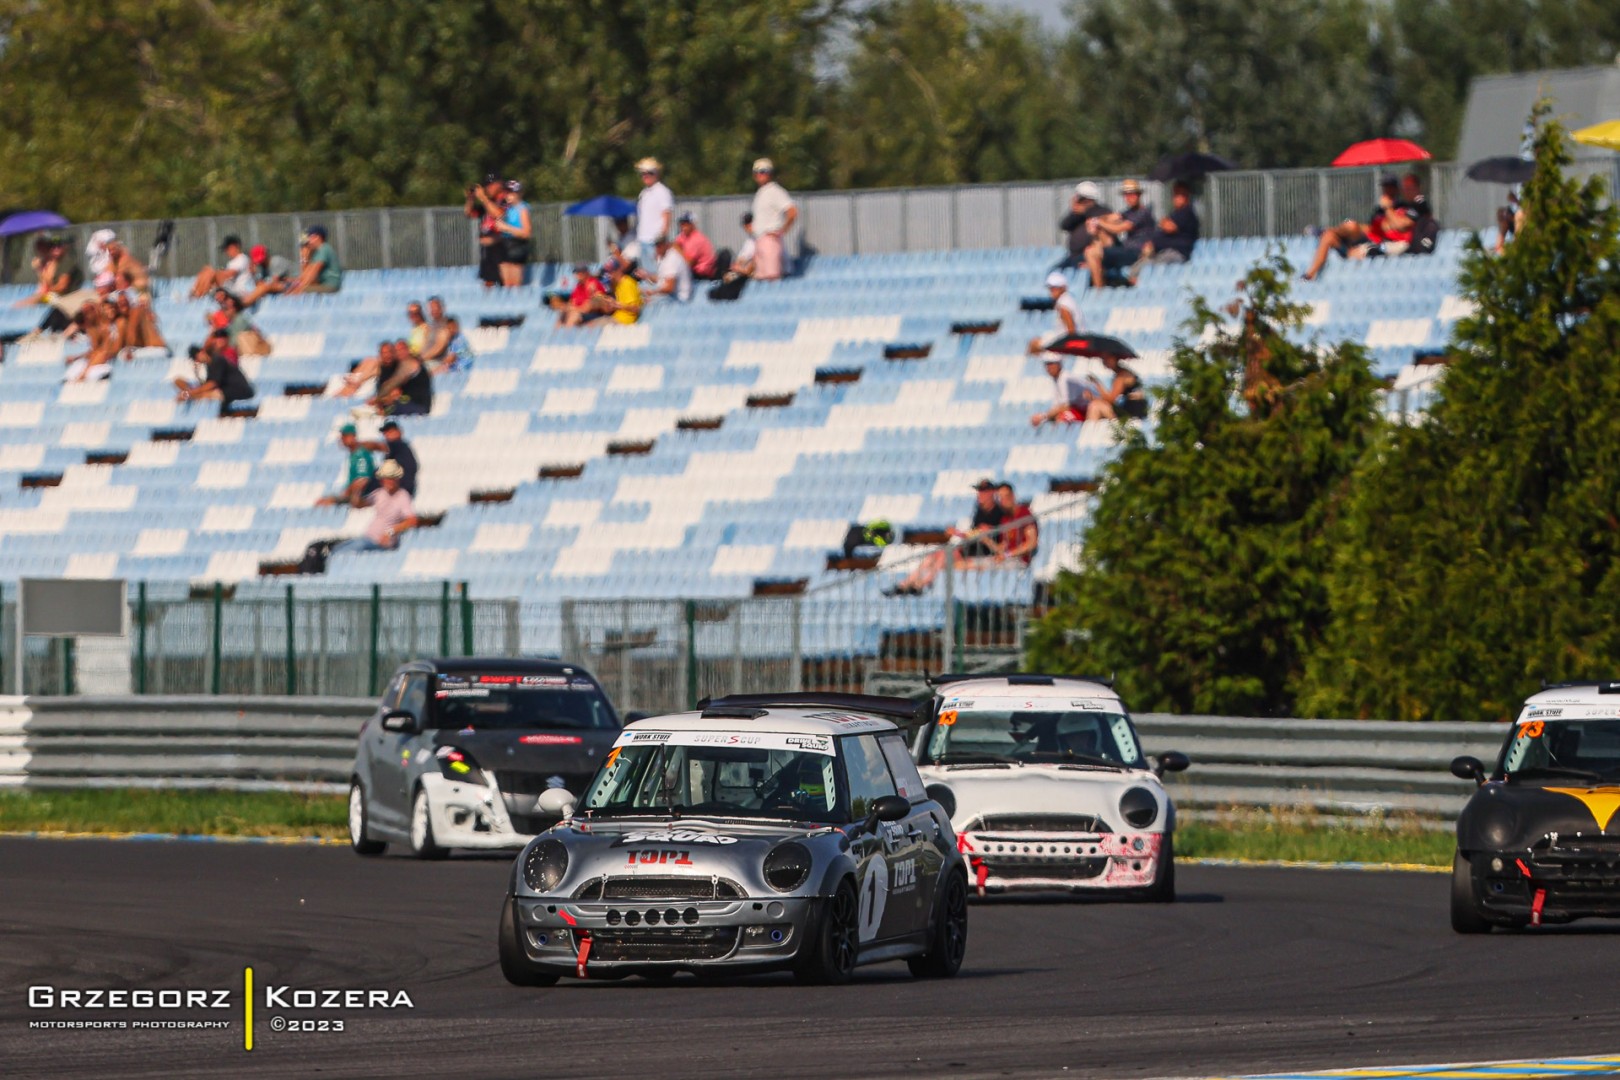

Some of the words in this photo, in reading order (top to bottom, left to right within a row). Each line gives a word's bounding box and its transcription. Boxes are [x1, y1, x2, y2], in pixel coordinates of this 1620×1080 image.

[1517, 720, 1545, 739] 73
[605, 746, 623, 768] 1
[622, 830, 738, 844] SQUAD
[627, 849, 693, 865] TOP1
[868, 869, 876, 928] 1
